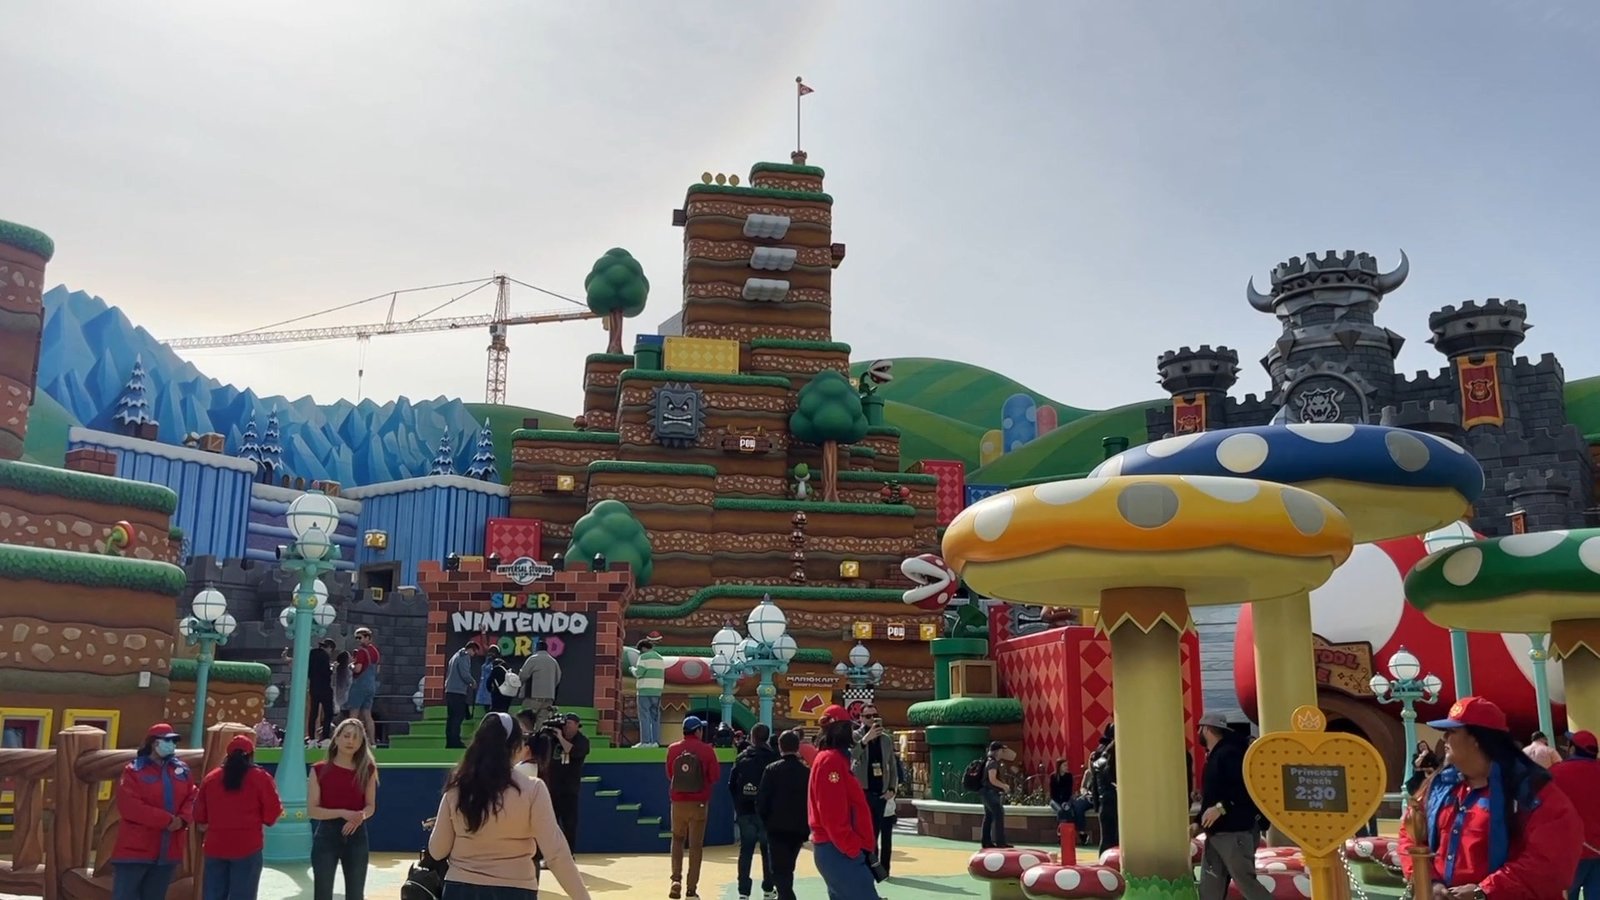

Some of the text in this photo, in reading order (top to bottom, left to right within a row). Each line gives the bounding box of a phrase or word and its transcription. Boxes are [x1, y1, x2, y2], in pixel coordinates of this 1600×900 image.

[490, 592, 551, 609] SUPER
[451, 610, 589, 635] NINTENDO
[1290, 767, 1339, 777] Princess
[1298, 776, 1332, 785] Peach
[1295, 785, 1336, 801] 2:30
